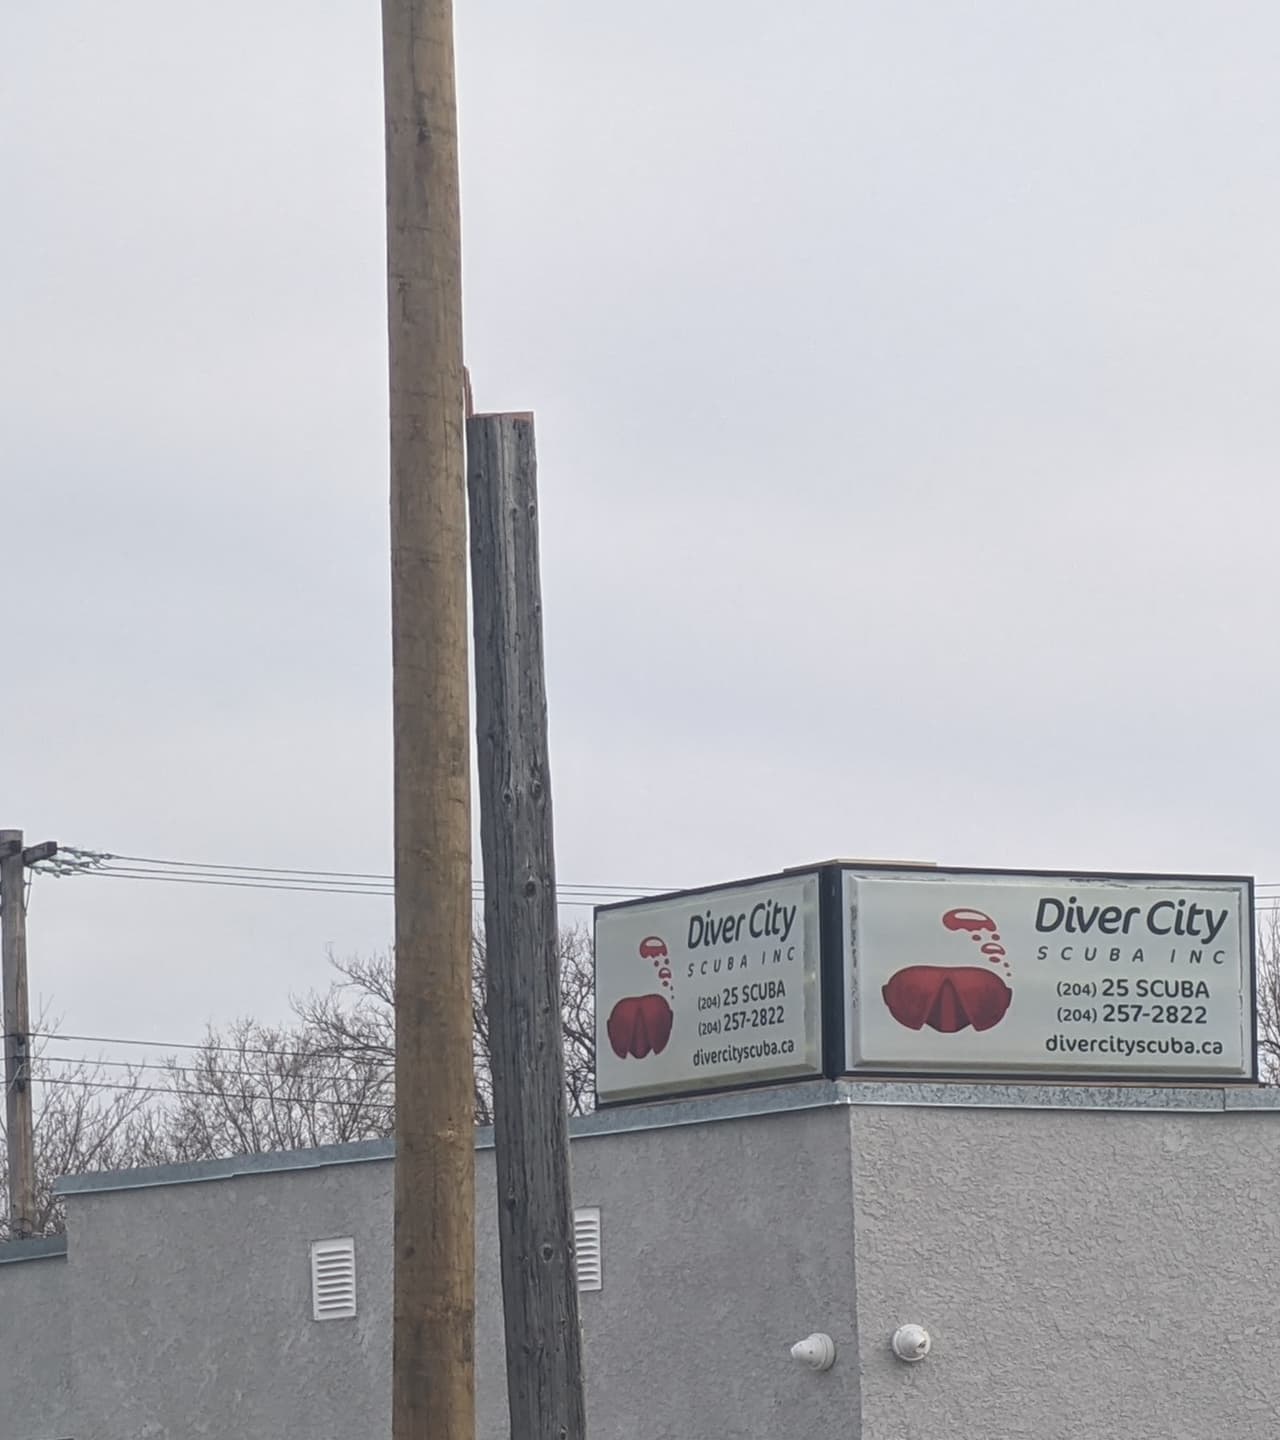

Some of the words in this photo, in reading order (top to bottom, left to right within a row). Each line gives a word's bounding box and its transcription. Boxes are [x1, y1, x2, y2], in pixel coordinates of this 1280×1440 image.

[686, 906, 747, 951] Diver
[750, 898, 798, 942] City
[1035, 897, 1140, 935] Diver
[1145, 899, 1229, 945] City
[687, 953, 748, 977] SCUBA
[760, 945, 796, 966] INC
[1036, 946, 1145, 963] SCUBA
[1169, 948, 1227, 965] INC
[697, 990, 722, 1011] (204)
[723, 984, 740, 1005] 25
[741, 979, 786, 1003] SCUBA
[1056, 979, 1098, 999] (204)
[1101, 978, 1131, 998] 25
[1135, 979, 1210, 999] SCUBA
[697, 1016, 722, 1037] (204)
[723, 1005, 785, 1032] 257-2822
[1056, 1005, 1098, 1024] (204)
[1102, 1003, 1208, 1024] 257-2822
[692, 1037, 795, 1067] divercityscuba.ca
[1045, 1034, 1224, 1056] divercityscuba.ca
